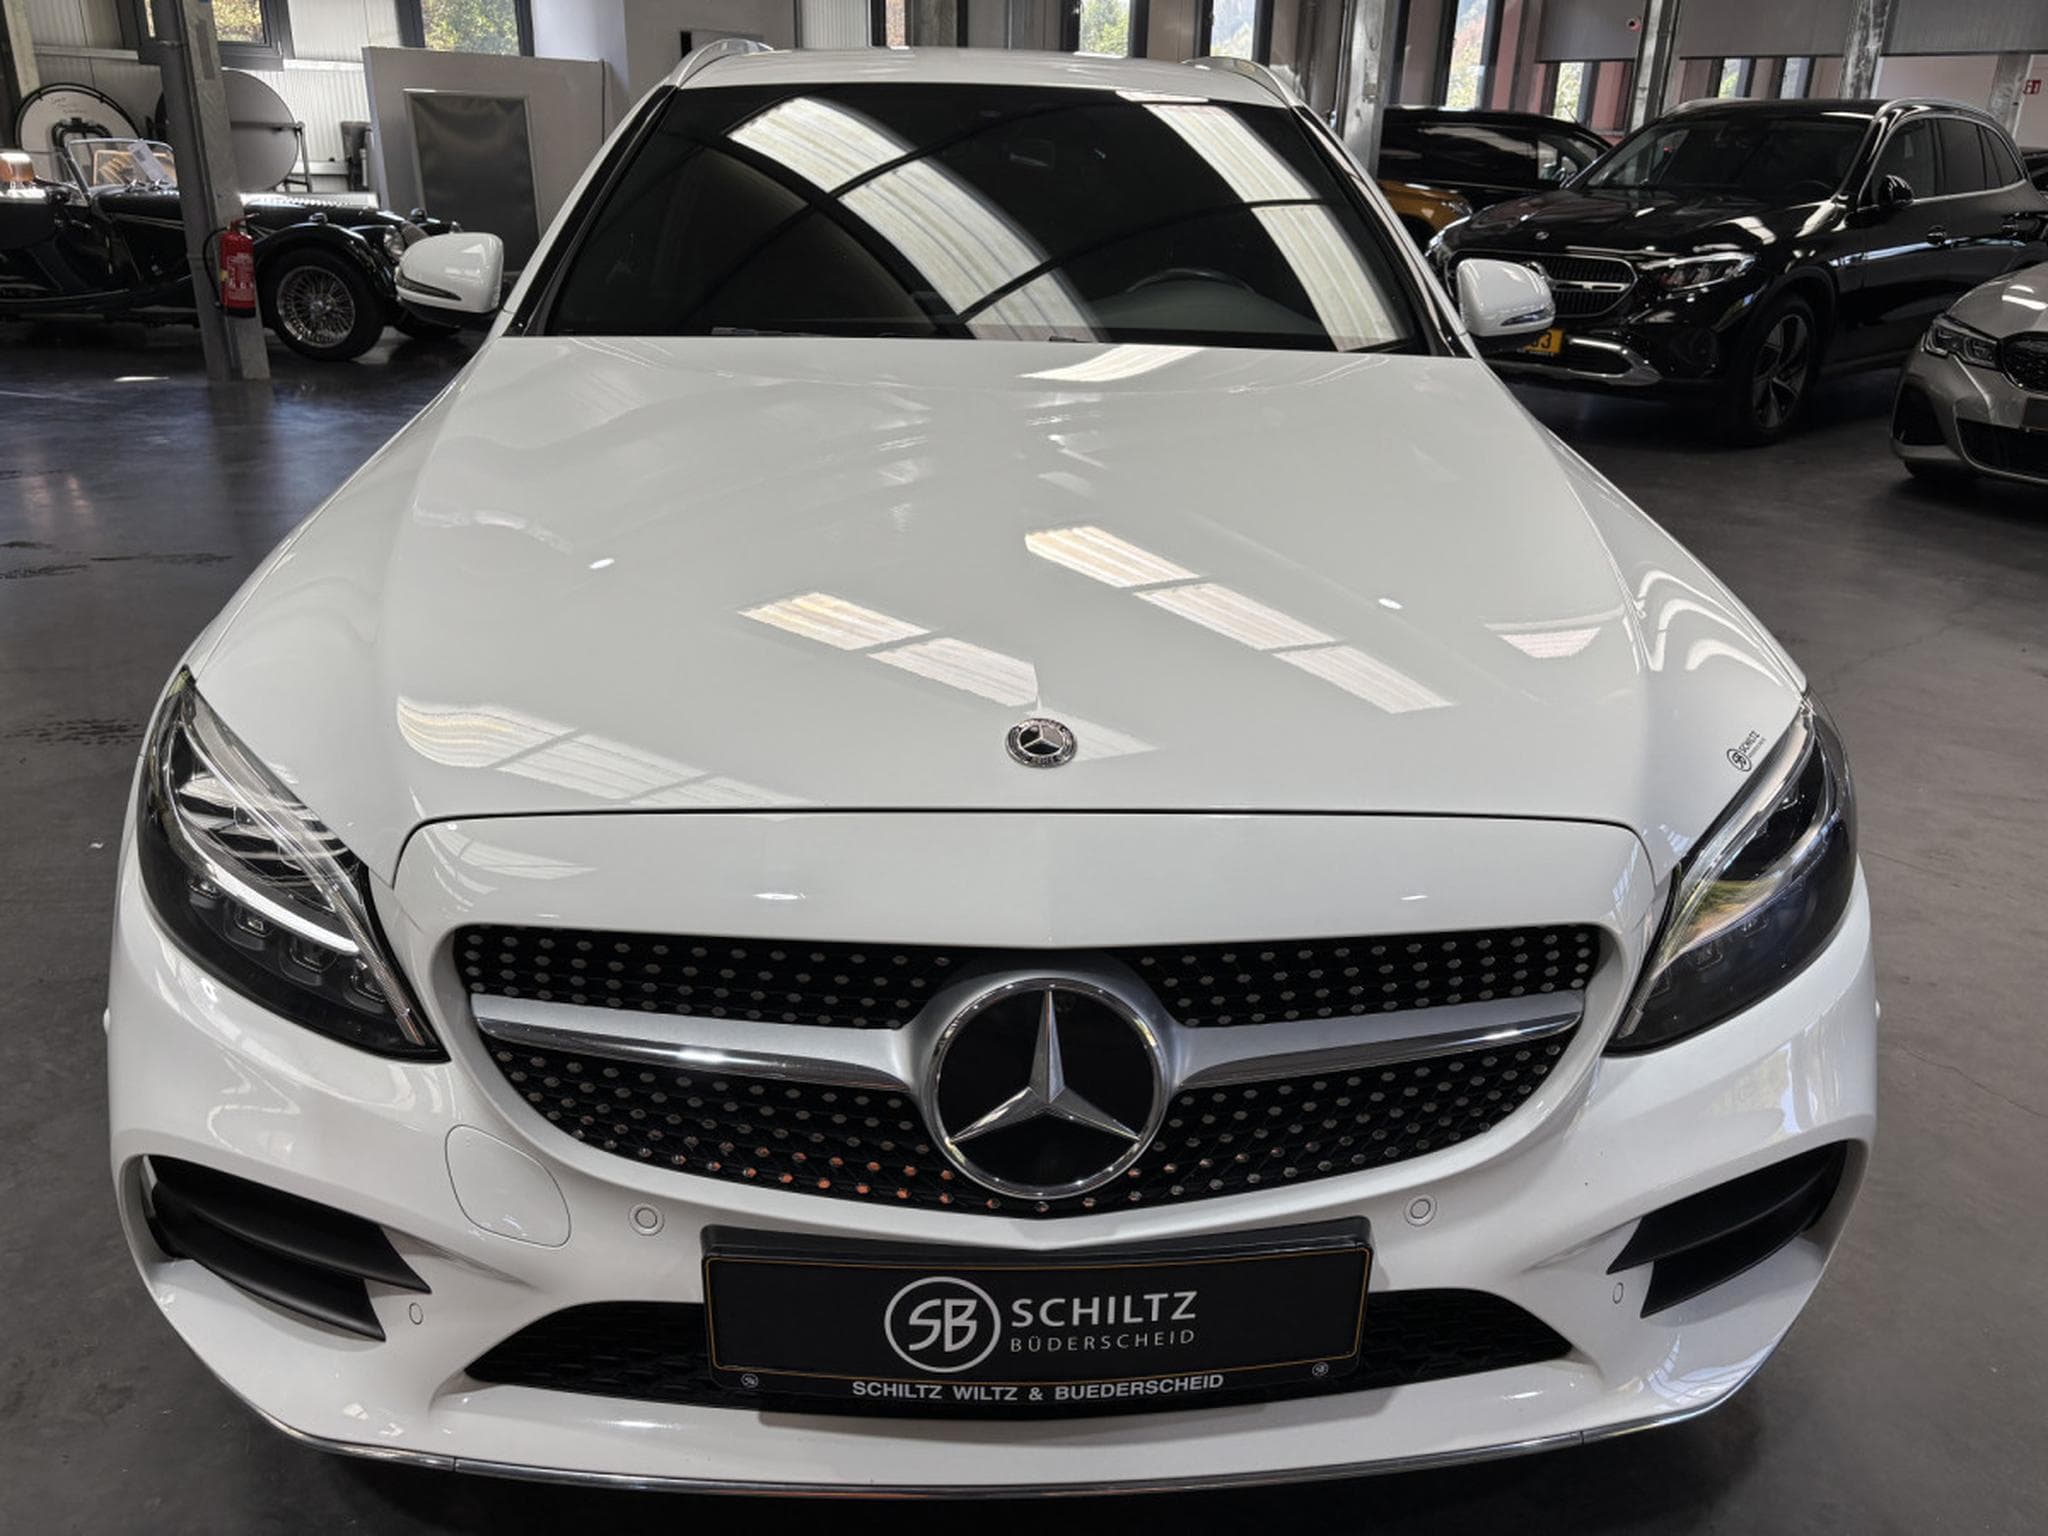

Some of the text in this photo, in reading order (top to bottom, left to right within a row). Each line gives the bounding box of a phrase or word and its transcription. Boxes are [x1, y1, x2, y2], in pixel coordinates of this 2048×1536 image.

[1011, 1291, 1198, 1327] SCHILTZ
[908, 1299, 978, 1352] SB
[1010, 1329, 1195, 1352] BÜDERSCHEID
[852, 1374, 1224, 1401] SCHILTZ WILTZ & BUEDERSCHEID
